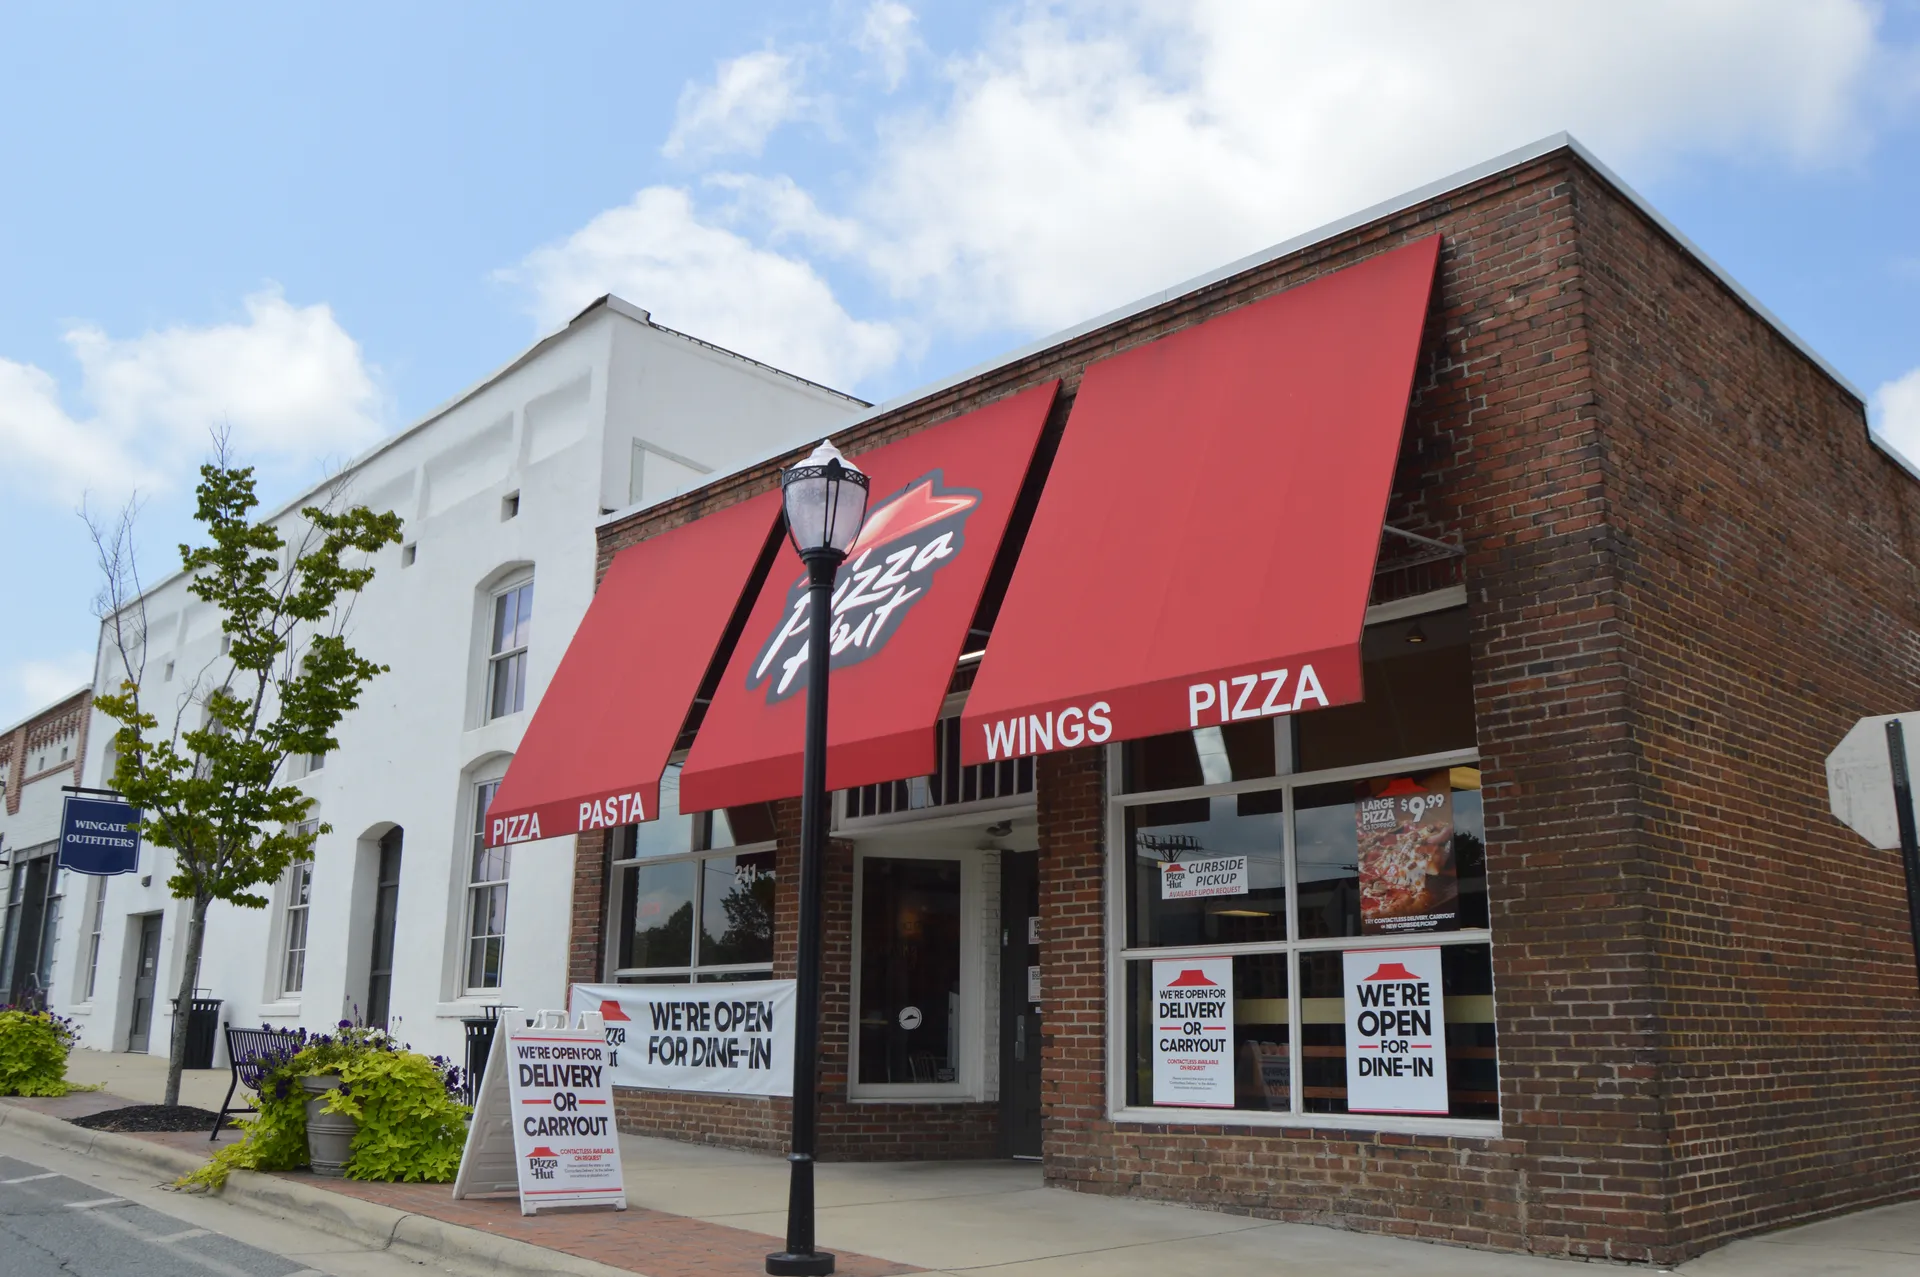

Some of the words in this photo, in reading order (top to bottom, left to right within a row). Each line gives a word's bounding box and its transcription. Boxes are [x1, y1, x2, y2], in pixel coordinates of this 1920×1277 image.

[756, 531, 954, 679] Pizza
[983, 701, 1113, 760] WINGS
[1188, 664, 1330, 727] PIZZA
[1362, 798, 1394, 812] LARGE
[492, 812, 541, 846] PIZZA
[579, 791, 645, 831] PASTA
[1362, 810, 1395, 824] PIZZA
[75, 820, 127, 832] WINGATE
[66, 834, 134, 848] OUTFITTERS
[1189, 859, 1244, 874] CURBSIDE
[1166, 872, 1185, 882] Pizza
[1196, 873, 1237, 886] PICKUP
[1169, 890, 1198, 898] AVAILABLE
[1160, 990, 1184, 999] WE'RE
[1185, 989, 1208, 999] OPEN
[1209, 989, 1226, 999] FOR
[1356, 982, 1431, 1007] WE'RE
[649, 1001, 710, 1031] WE'RE
[714, 1001, 774, 1033] OPEN
[1160, 1002, 1226, 1018] DELIVERY
[1183, 1022, 1202, 1035] OR
[1357, 1009, 1432, 1037] OPEN
[603, 1026, 626, 1047] zza
[1160, 1038, 1226, 1052] CARRYOUT
[1381, 1040, 1409, 1054] FOR
[517, 1046, 551, 1059] WE'RE
[552, 1047, 580, 1060] OPEN
[581, 1048, 602, 1060] FOR
[648, 1036, 687, 1067] FOR
[690, 1037, 771, 1070] DINE-IN
[1358, 1057, 1434, 1077] DINE-IN
[519, 1064, 602, 1088] DELIVERY
[553, 1092, 577, 1111] OR
[523, 1116, 608, 1137] CARRYOUT
[530, 1158, 558, 1170] Pizza
[531, 1168, 554, 1179] Hut
